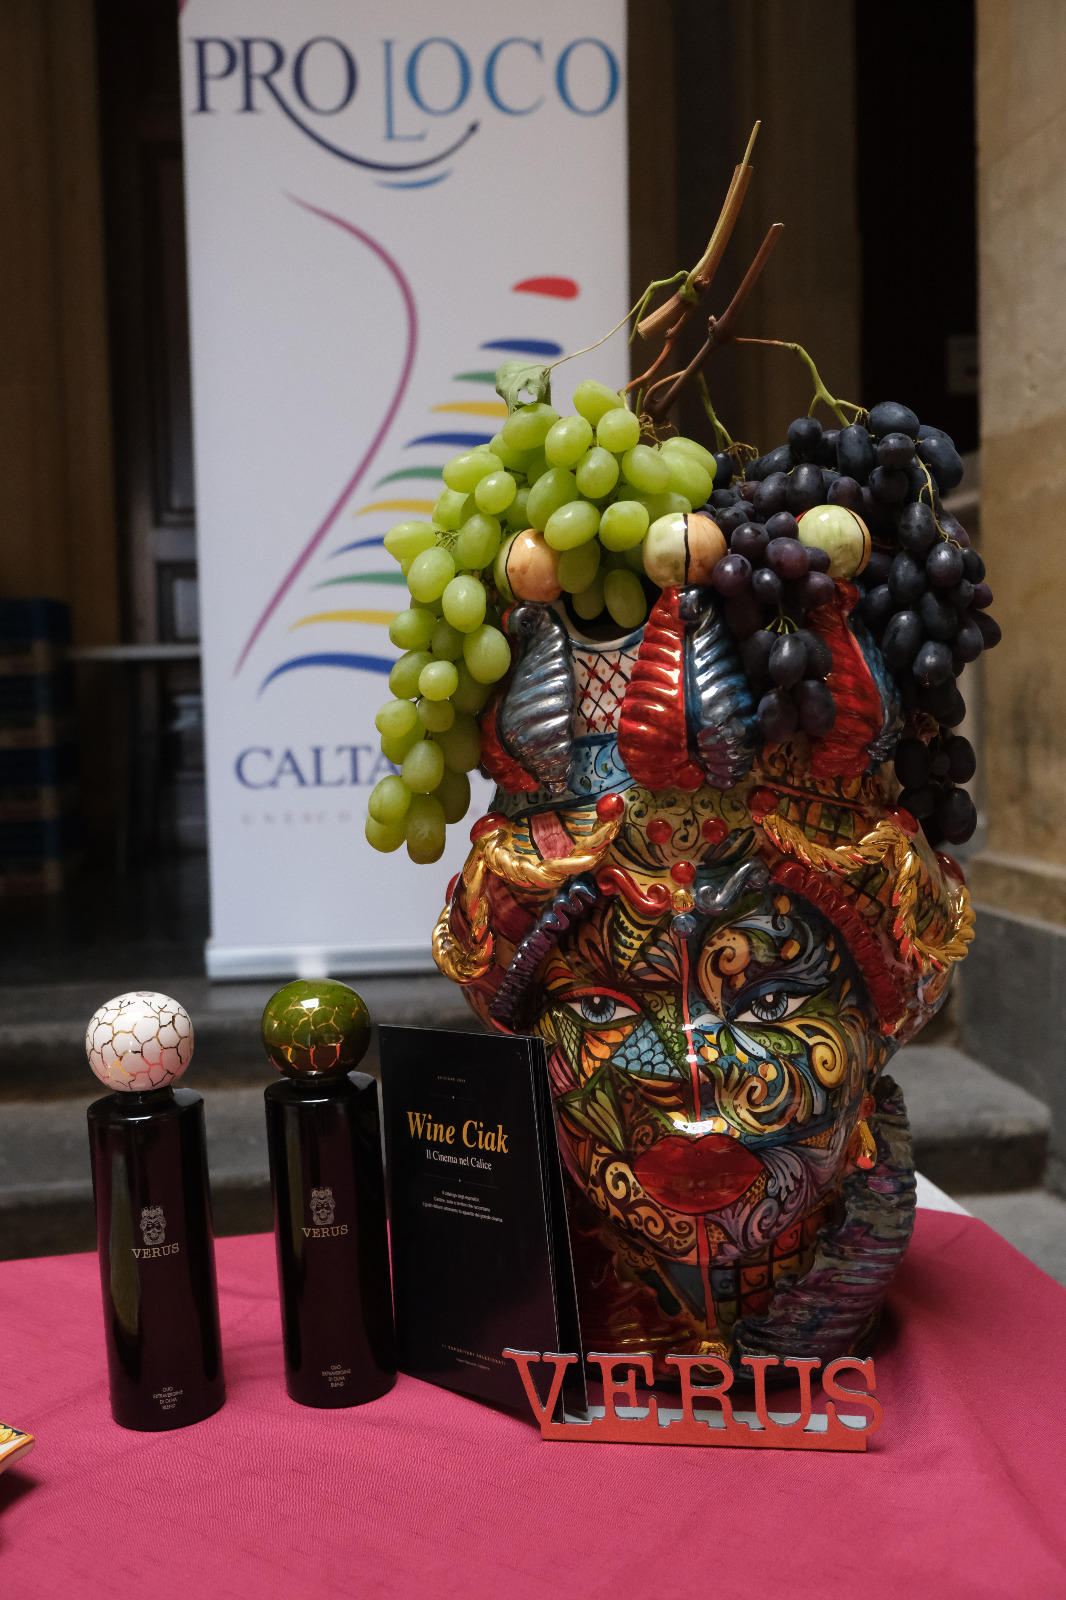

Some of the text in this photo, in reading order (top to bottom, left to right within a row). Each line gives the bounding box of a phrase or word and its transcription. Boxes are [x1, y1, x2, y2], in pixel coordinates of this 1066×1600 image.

[190, 35, 621, 142] PRO LOCO
[405, 1111, 509, 1154] Wine Ciak
[426, 1149, 493, 1171] Il Cinema nel Calice
[302, 1224, 349, 1238] VERUS
[131, 1243, 180, 1259] VERUS
[501, 1347, 884, 1440] VERUS
